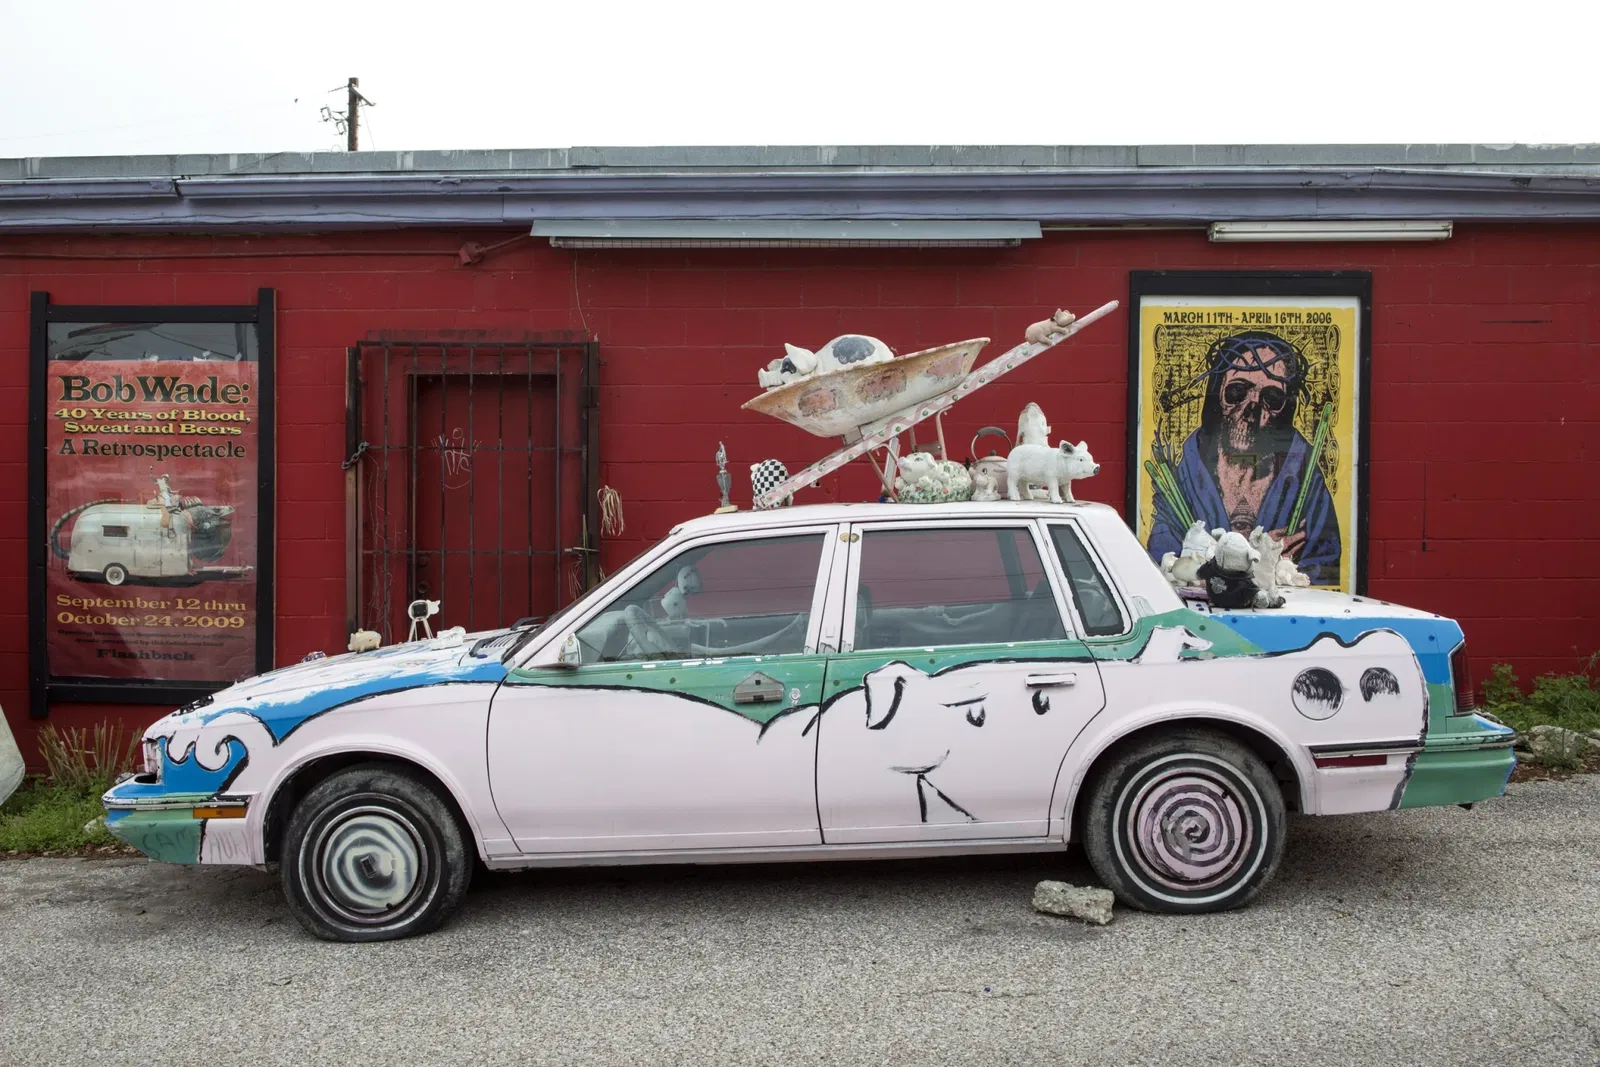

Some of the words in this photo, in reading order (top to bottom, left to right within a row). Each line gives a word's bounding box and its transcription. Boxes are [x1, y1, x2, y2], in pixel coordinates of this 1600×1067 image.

[1163, 311, 1203, 324] MARCH
[1206, 312, 1233, 324] 11TH
[1241, 312, 1272, 324] APRIL
[1306, 312, 1332, 324] 2006
[58, 375, 136, 403] Bob
[136, 375, 250, 404] Wade:
[54, 408, 87, 420] 40
[90, 408, 152, 420] Years
[155, 409, 179, 421] of
[182, 409, 251, 423] Blood,
[64, 421, 131, 434] Sweat
[134, 422, 174, 434] and
[179, 423, 242, 435] Beers
[59, 438, 78, 455] A
[82, 438, 246, 461] Retrospectacle
[56, 594, 171, 610] September
[175, 598, 200, 610] 12
[204, 600, 247, 611] thru
[56, 612, 140, 626] October
[183, 616, 245, 629] 2009
[96, 648, 196, 661] Flashback
